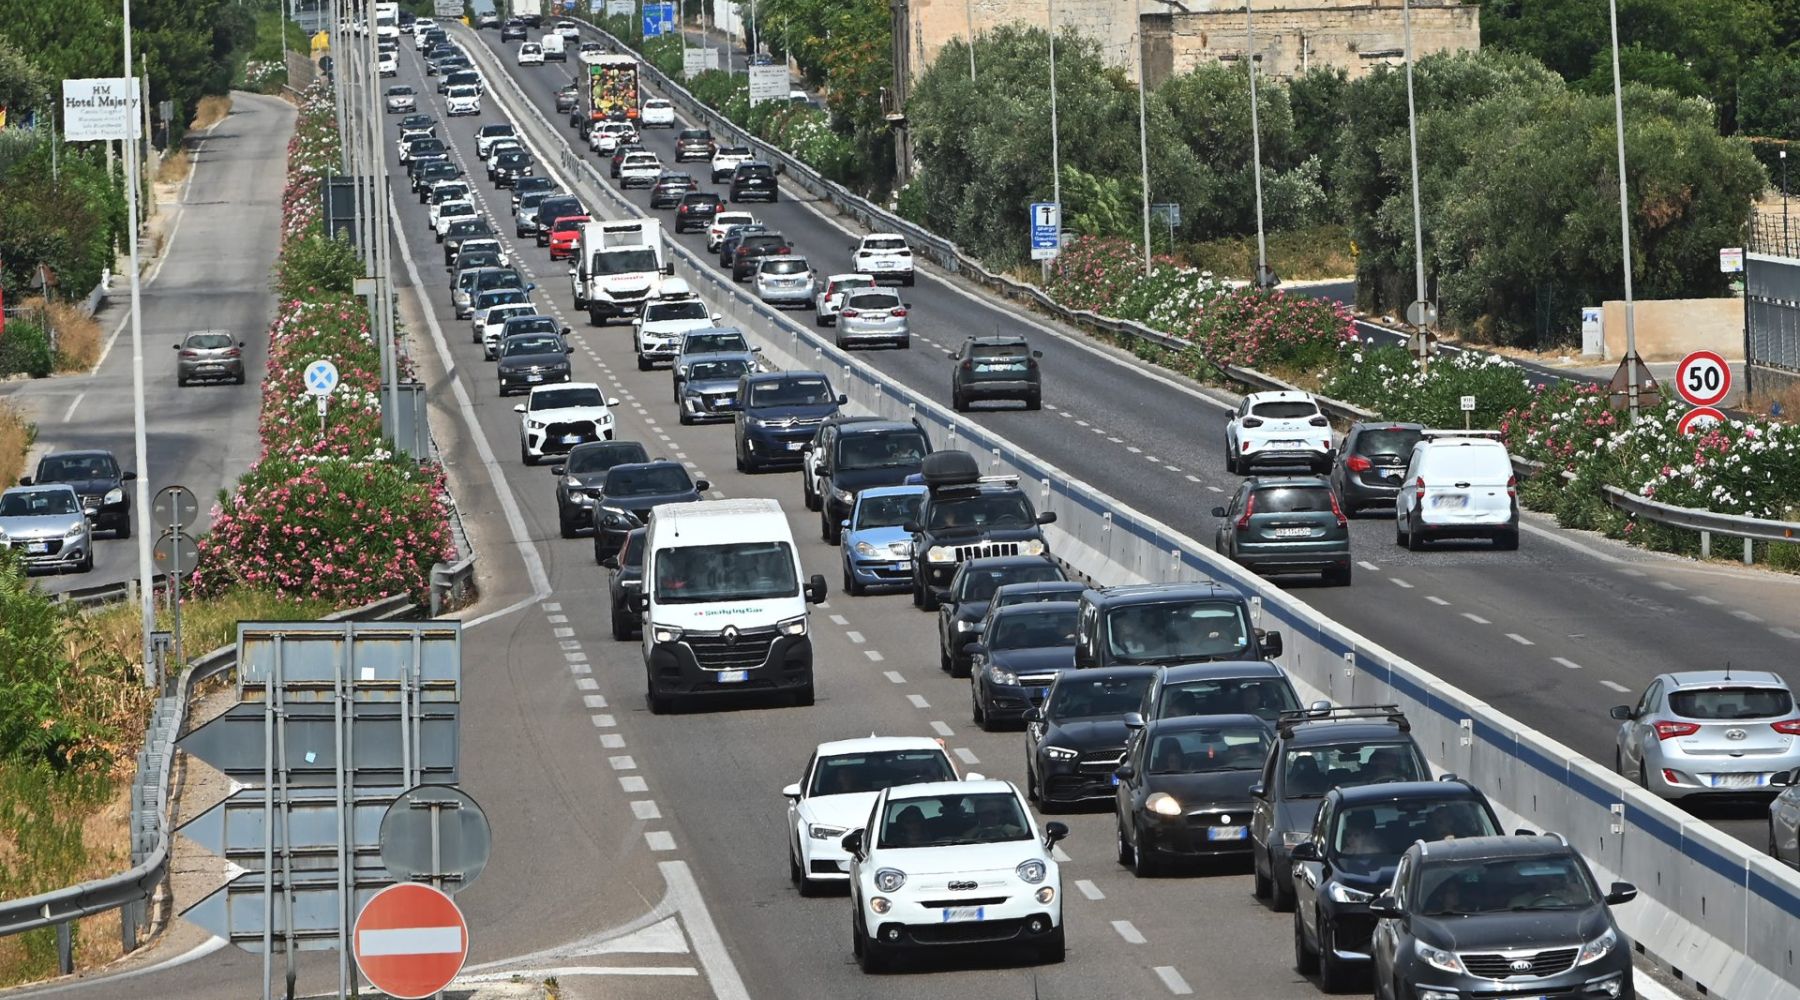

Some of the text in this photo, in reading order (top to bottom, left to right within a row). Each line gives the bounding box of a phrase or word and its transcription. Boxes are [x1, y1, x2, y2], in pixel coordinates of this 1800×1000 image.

[93, 86, 111, 94] HM
[65, 96, 95, 108] Hotel
[1688, 366, 1720, 392] 50
[1511, 963, 1531, 971] KIA
